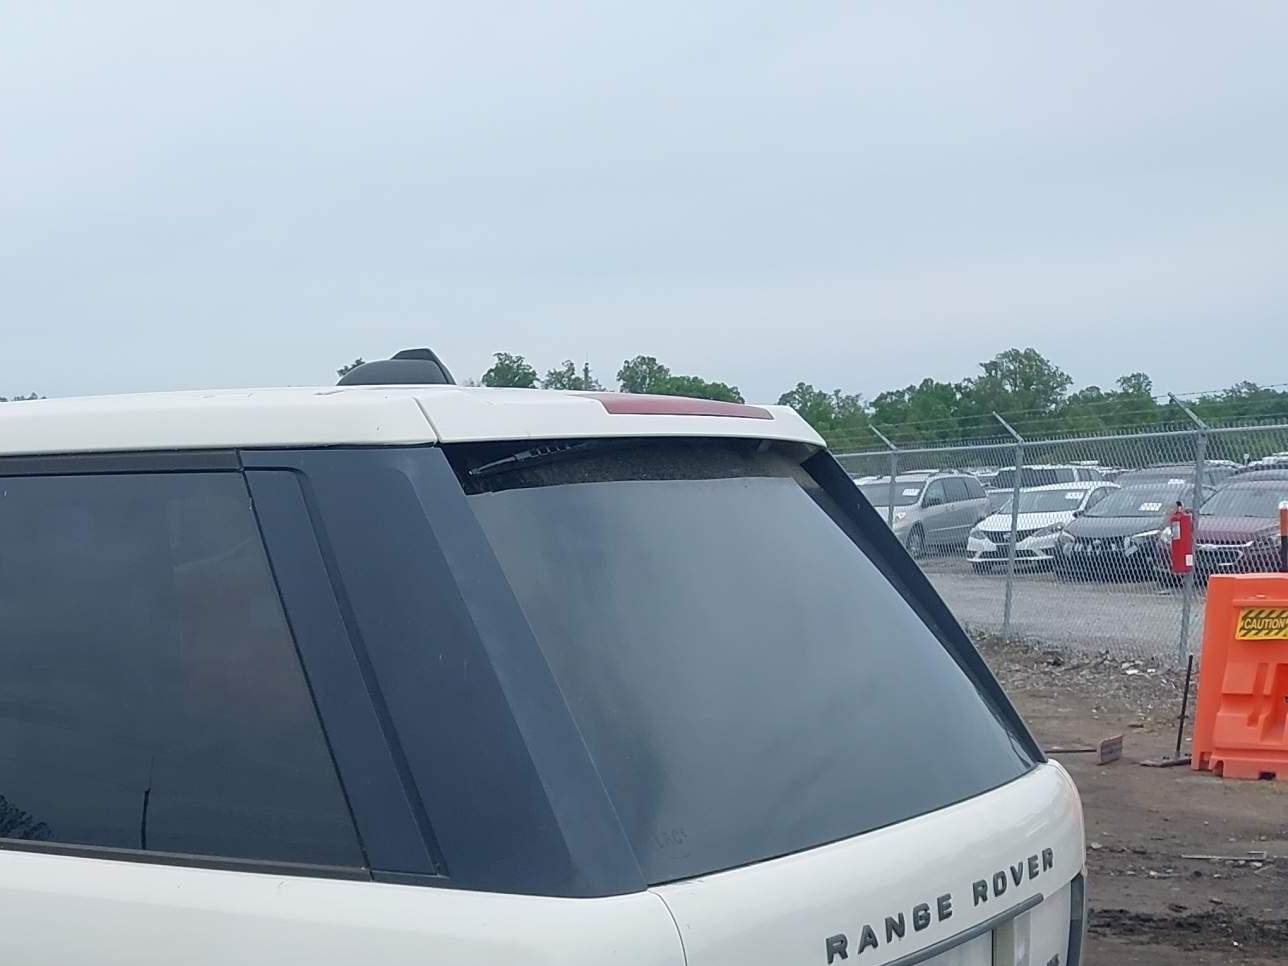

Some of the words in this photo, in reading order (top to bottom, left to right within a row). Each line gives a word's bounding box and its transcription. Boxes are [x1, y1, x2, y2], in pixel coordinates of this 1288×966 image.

[1244, 618, 1285, 630] CAUTION
[825, 893, 953, 965] RANGE
[972, 847, 1054, 907] ROVER
